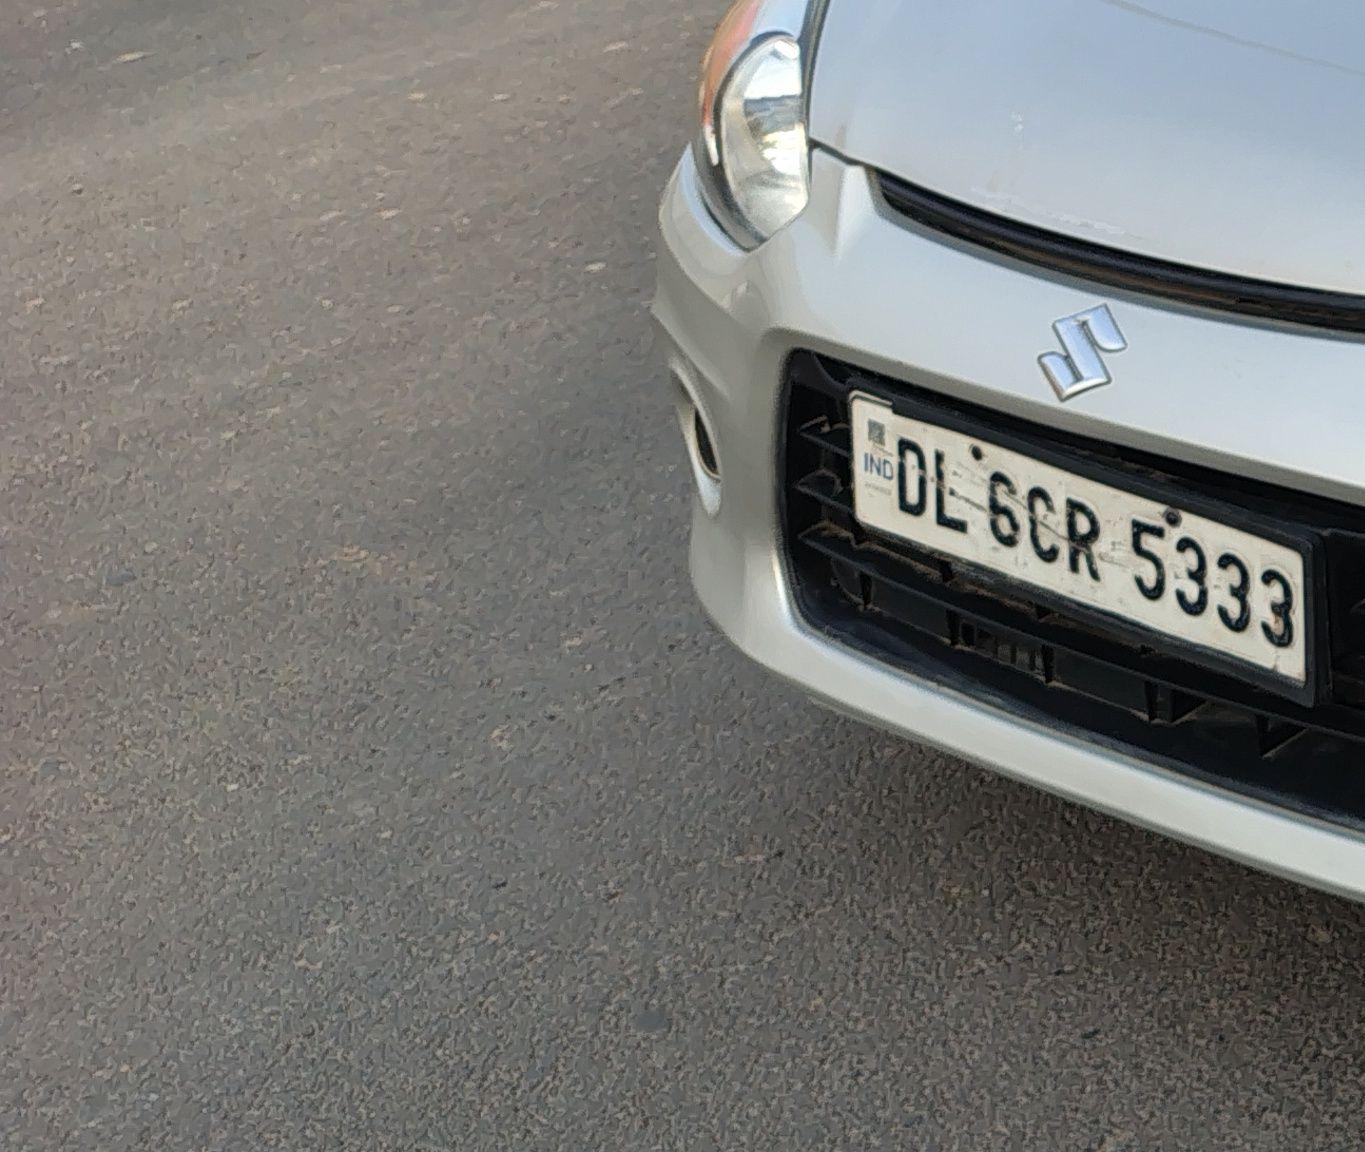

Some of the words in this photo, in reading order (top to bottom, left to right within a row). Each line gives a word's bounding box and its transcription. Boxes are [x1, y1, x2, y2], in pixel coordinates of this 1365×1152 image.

[864, 451, 894, 481] IND
[897, 437, 968, 534] DL
[988, 470, 1101, 582] 6CR
[1130, 517, 1295, 648] 5333
